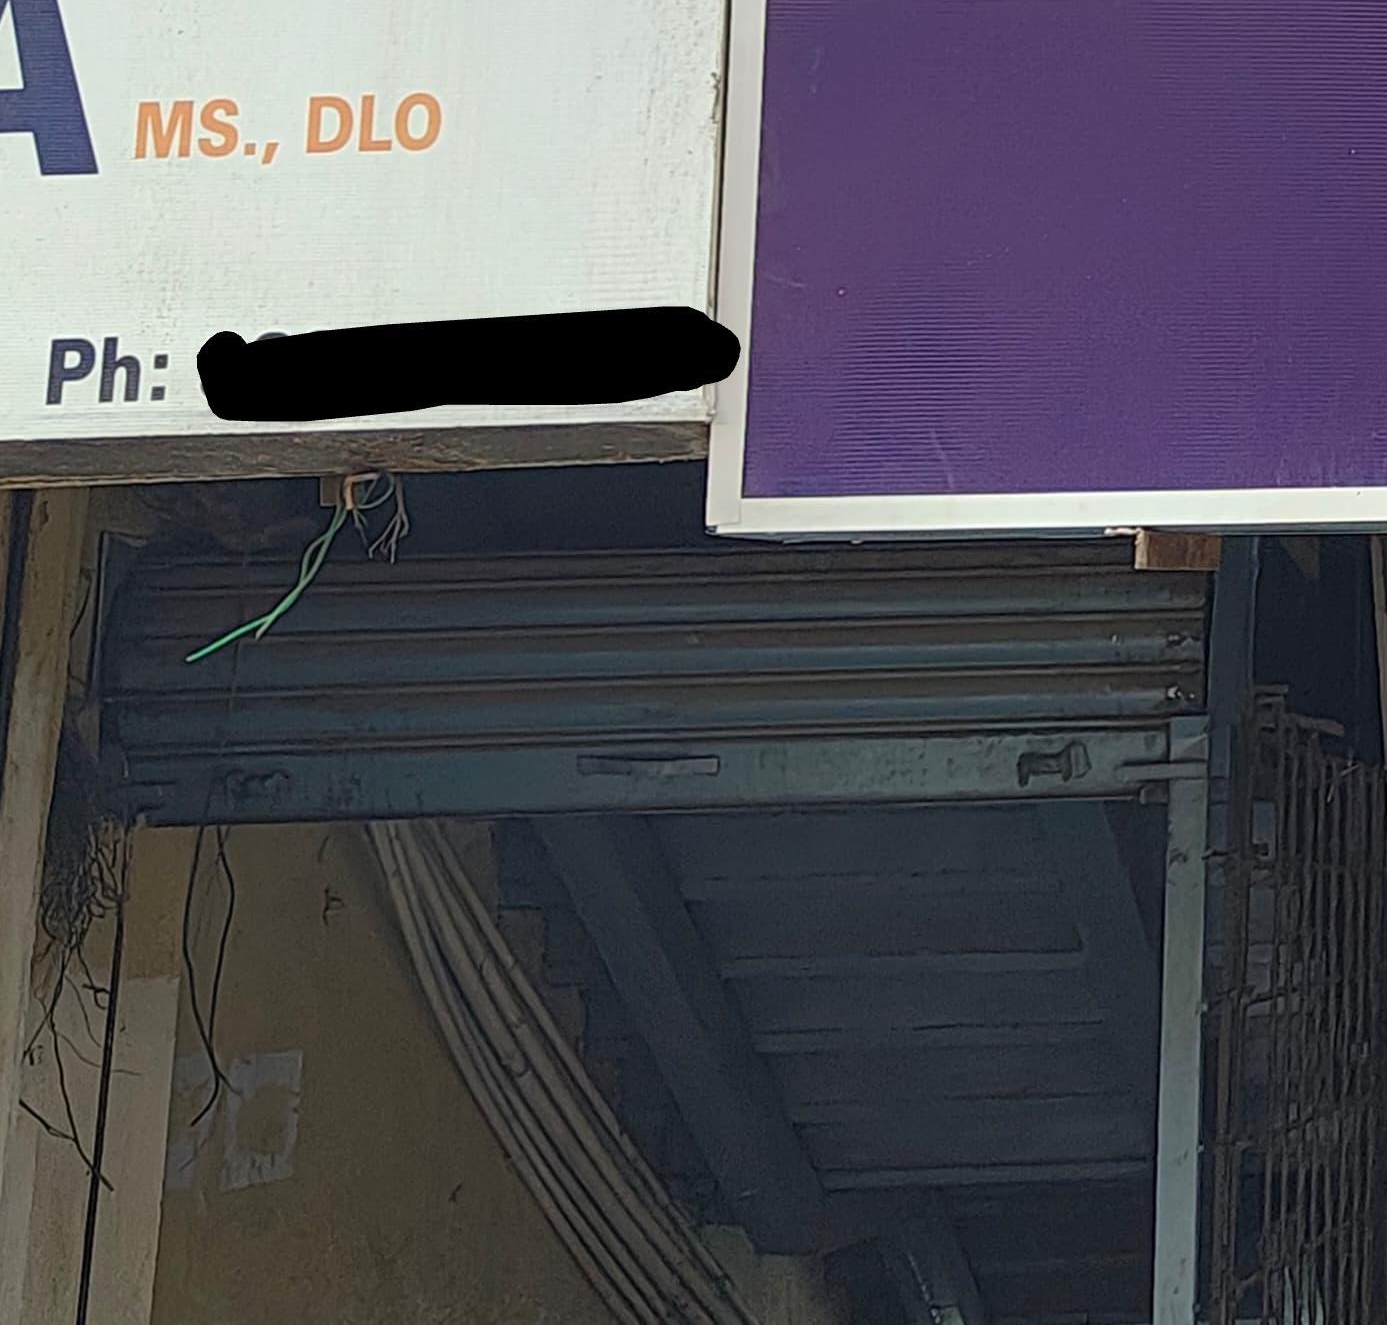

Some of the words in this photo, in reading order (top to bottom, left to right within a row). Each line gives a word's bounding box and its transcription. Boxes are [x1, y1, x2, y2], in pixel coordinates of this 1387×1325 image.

[134, 98, 279, 165] MS.,
[304, 92, 444, 154] DLO
[45, 337, 169, 406] Ph:
